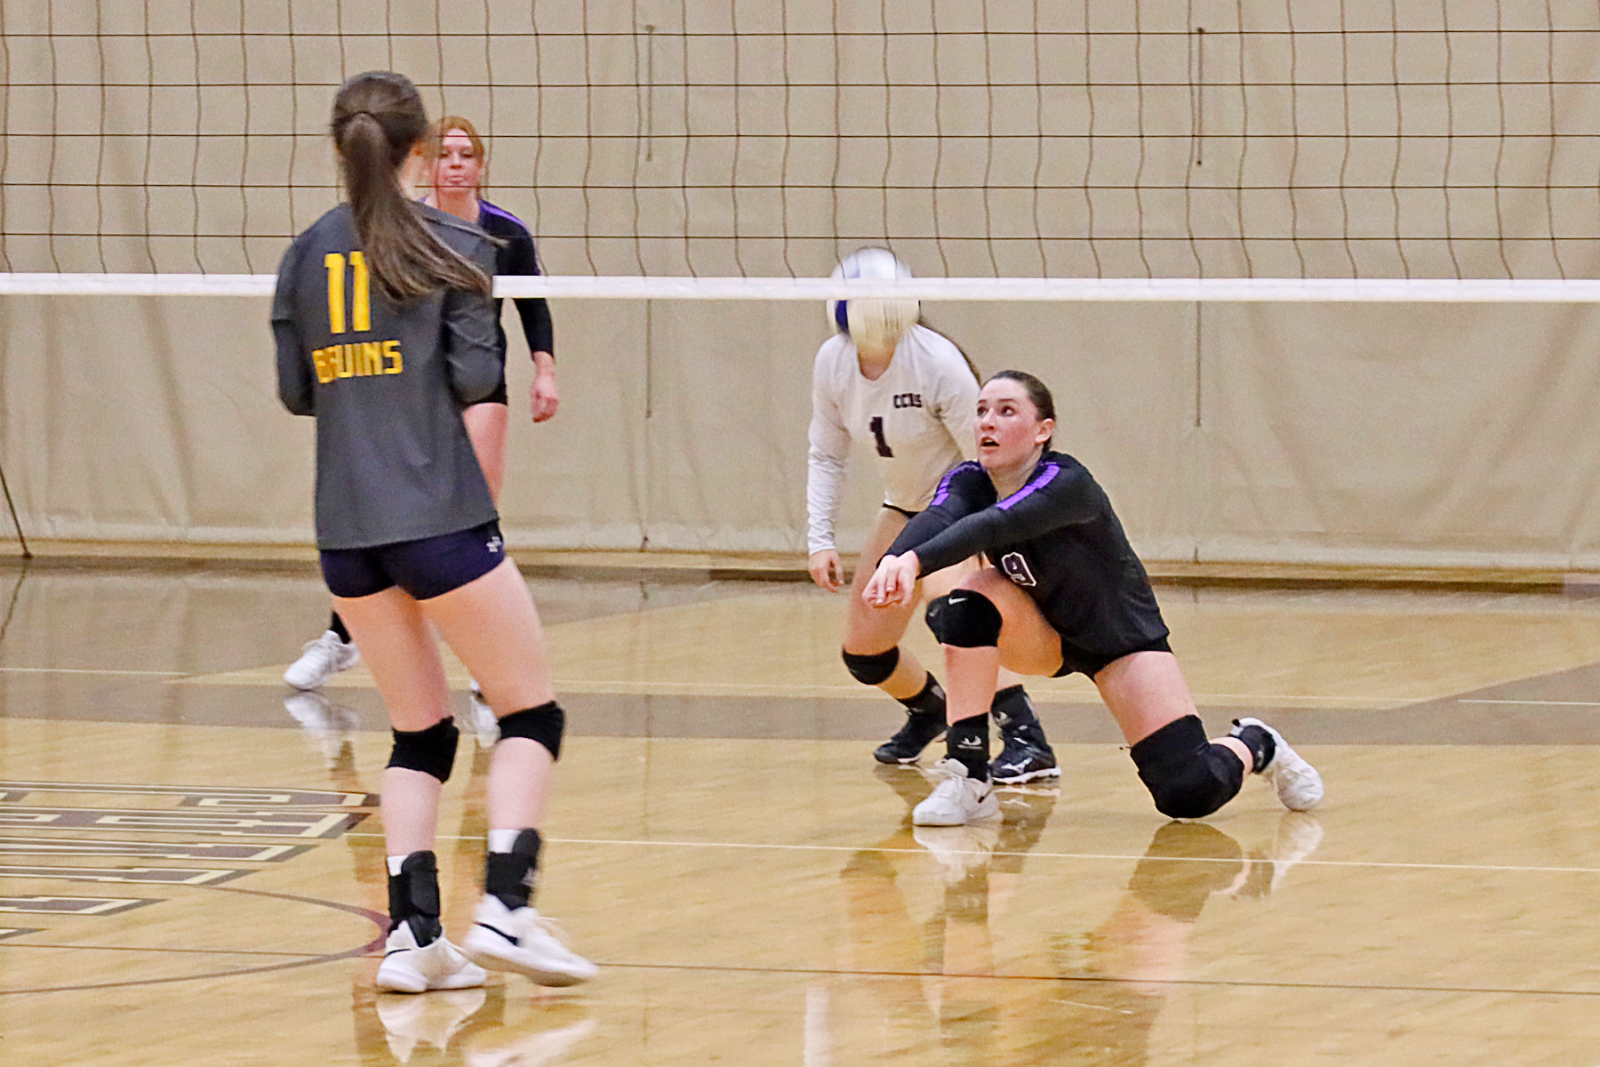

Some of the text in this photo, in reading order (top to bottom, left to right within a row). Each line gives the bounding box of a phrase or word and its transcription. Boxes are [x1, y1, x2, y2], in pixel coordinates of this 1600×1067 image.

[324, 250, 371, 334] 11
[869, 416, 894, 458] 1
[1001, 551, 1037, 587] 9
